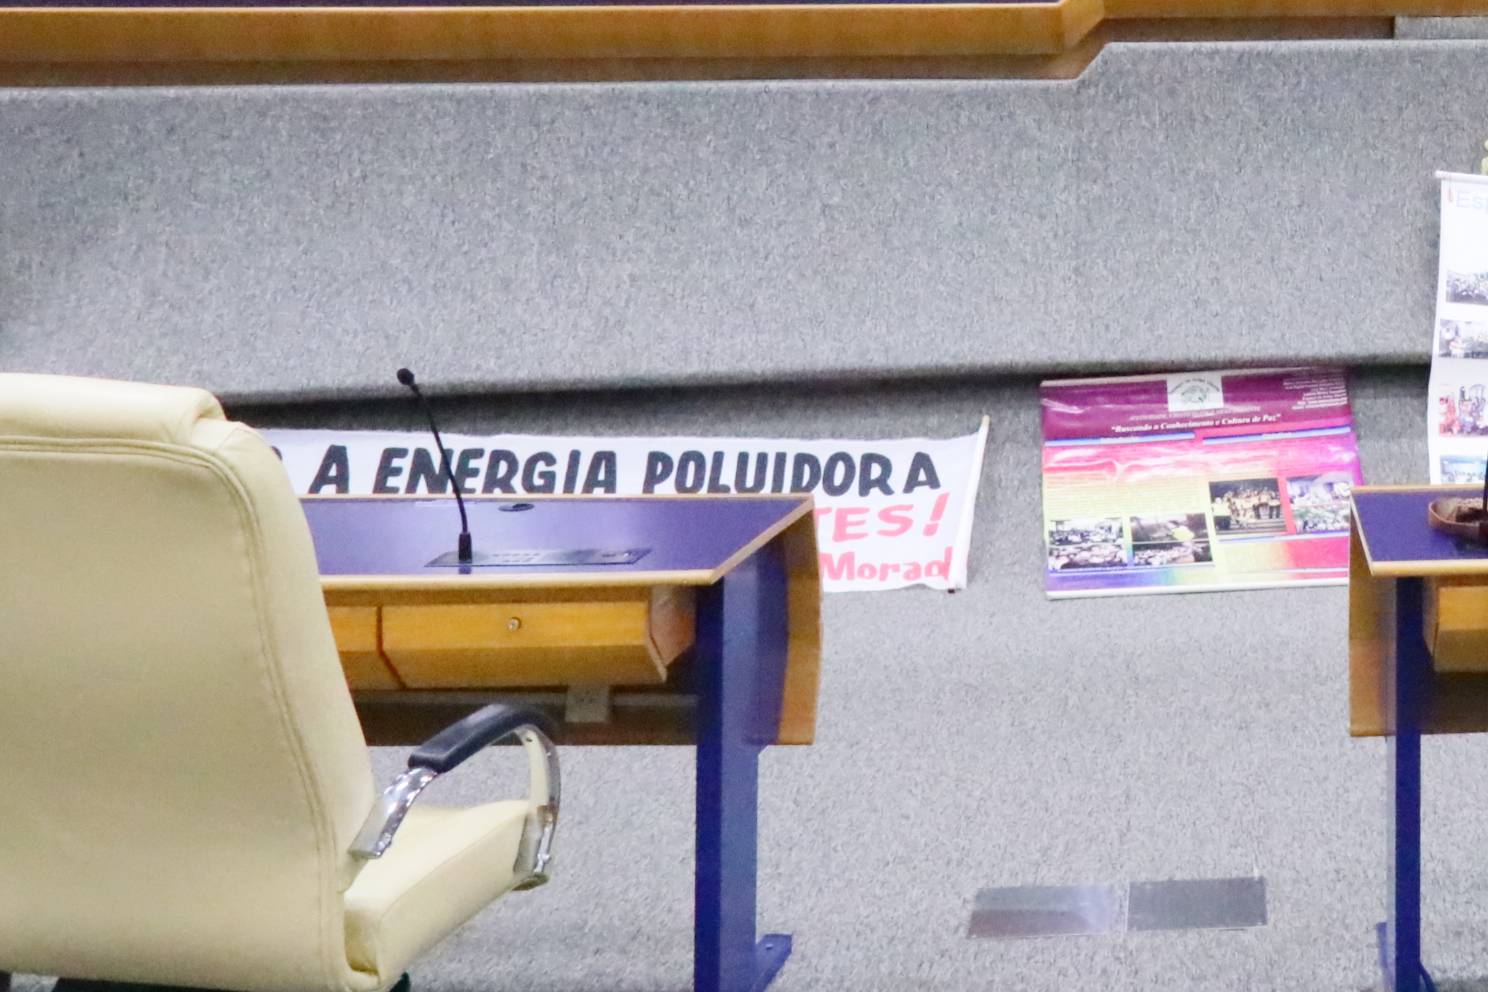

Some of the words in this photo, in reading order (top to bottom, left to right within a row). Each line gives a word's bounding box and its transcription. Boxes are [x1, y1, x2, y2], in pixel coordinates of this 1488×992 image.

[1160, 419, 1214, 430] Conhecimento
[1221, 416, 1250, 425] Cultura
[1252, 415, 1261, 423] de
[308, 445, 350, 494] A
[372, 446, 617, 494] ENERGIA
[642, 450, 942, 497] POLUIDORA
